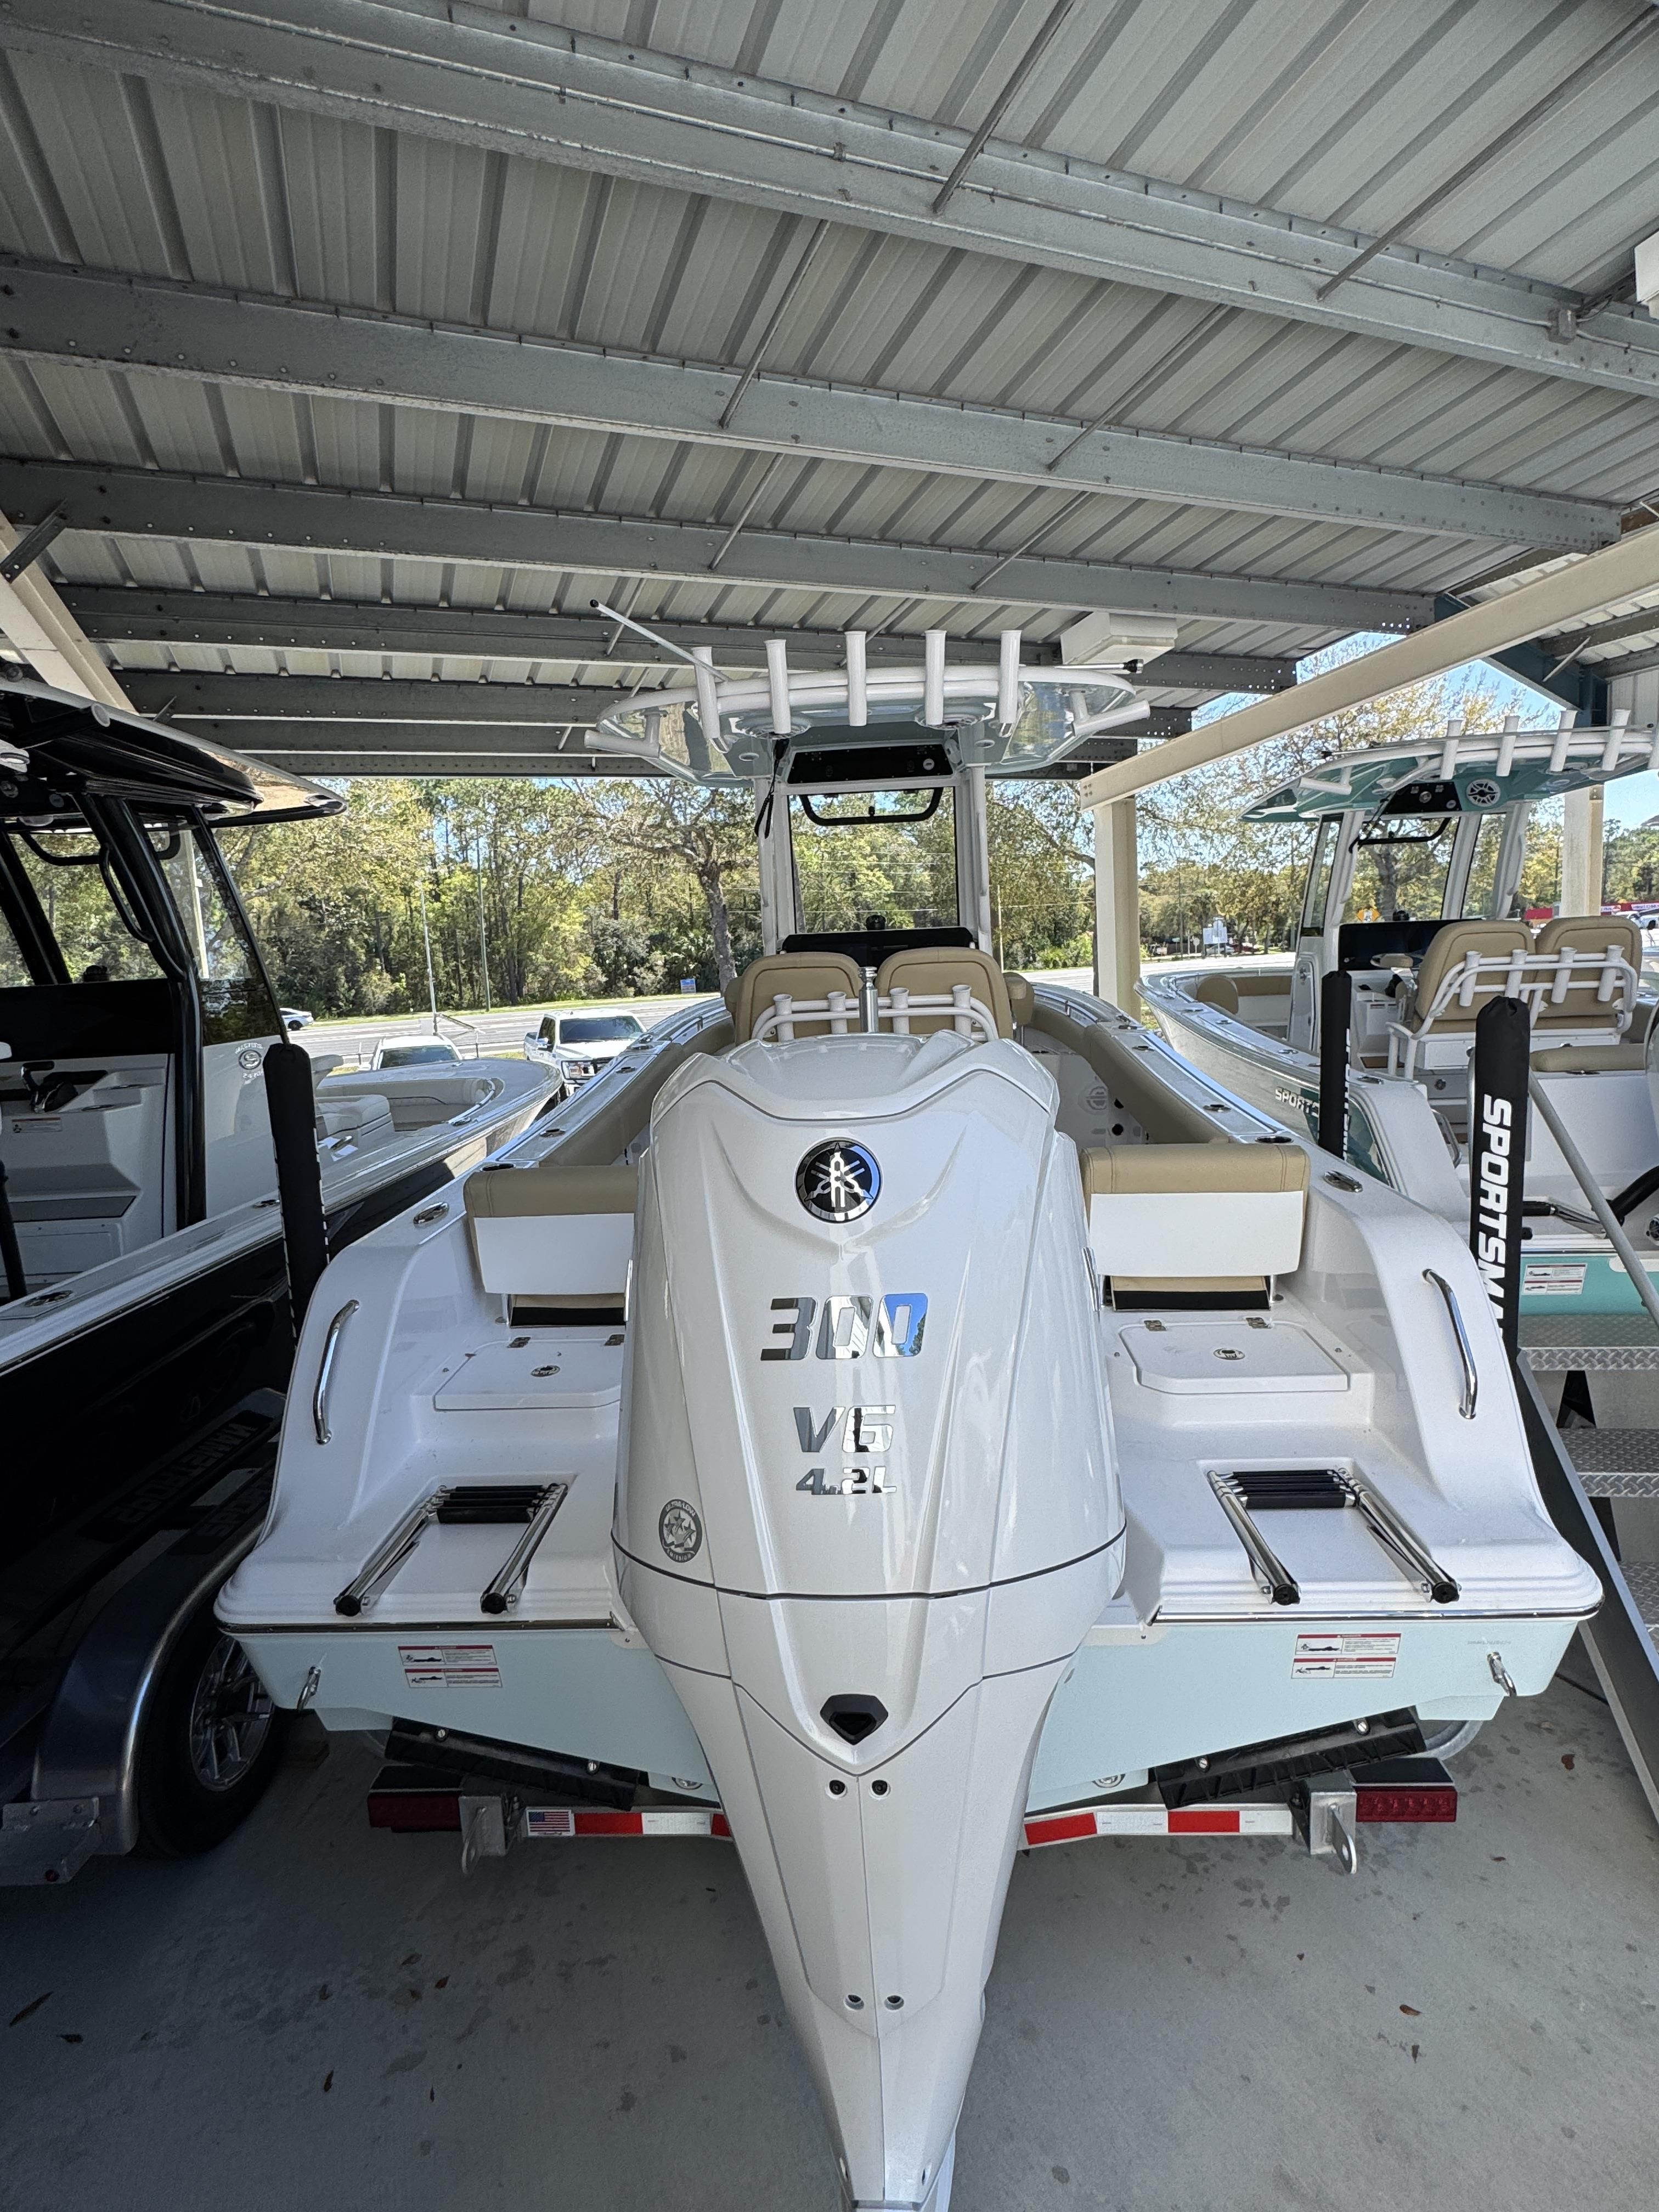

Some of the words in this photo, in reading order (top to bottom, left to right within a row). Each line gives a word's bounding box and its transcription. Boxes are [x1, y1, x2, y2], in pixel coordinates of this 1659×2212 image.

[760, 1293, 929, 1362] 300
[793, 1404, 897, 1453] V6
[795, 1466, 897, 1496] 4.2L
